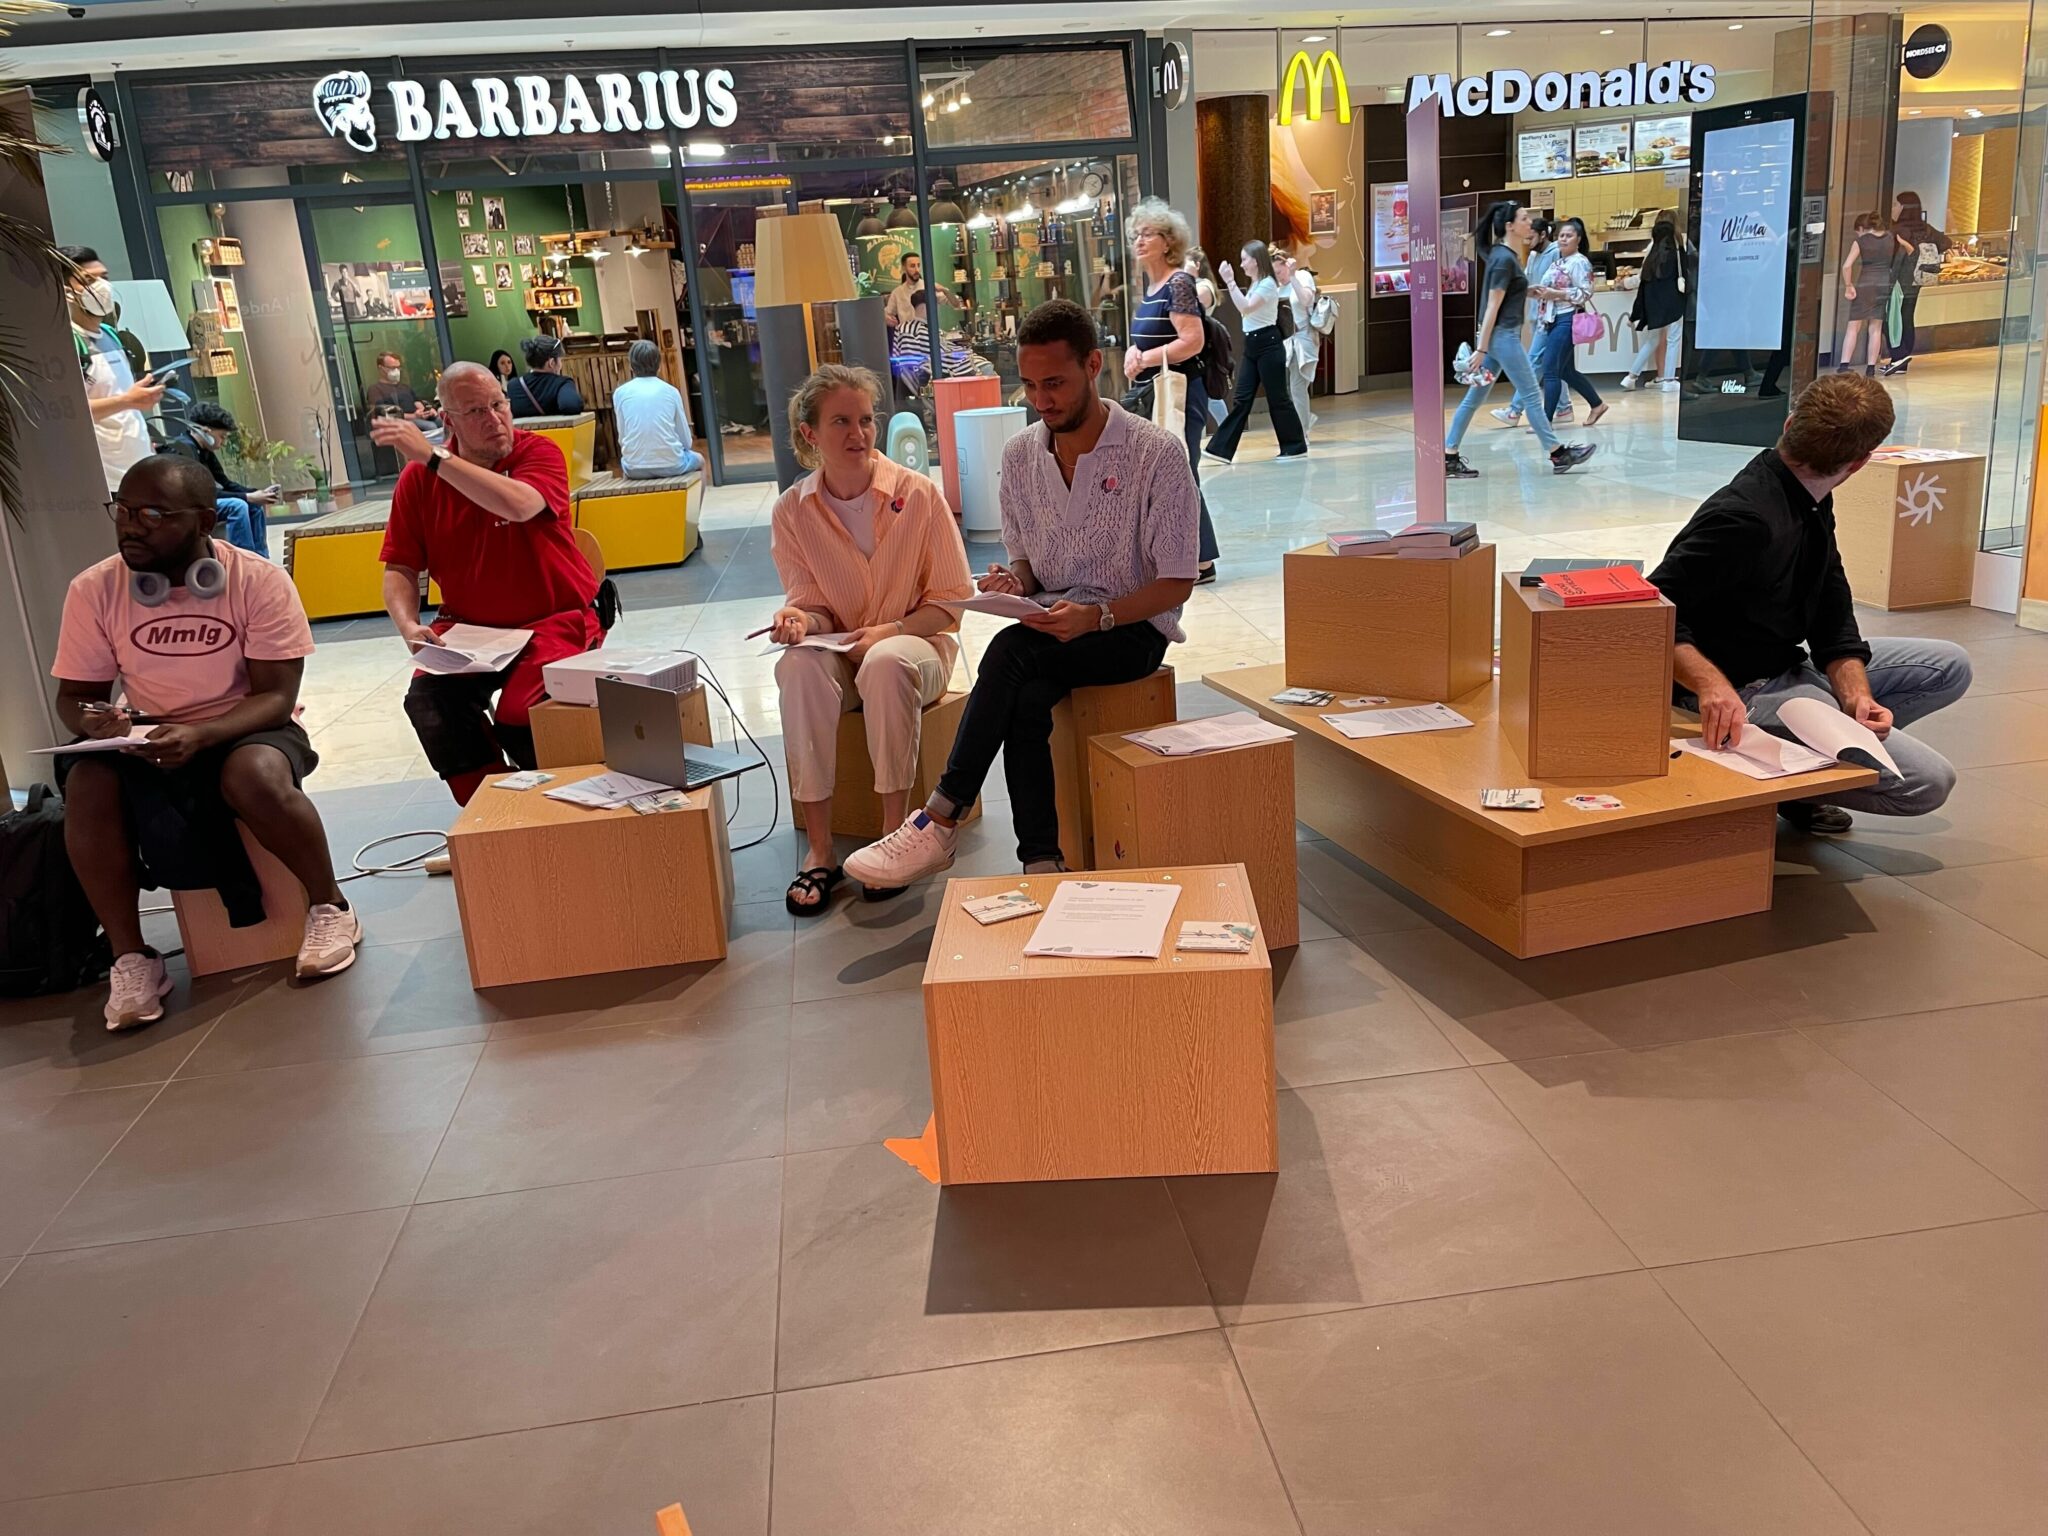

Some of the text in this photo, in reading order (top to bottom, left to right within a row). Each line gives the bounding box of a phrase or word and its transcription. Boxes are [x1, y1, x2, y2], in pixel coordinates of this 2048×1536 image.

[1906, 46, 1935, 58] NORDSEE
[1407, 60, 1716, 117] McDonald's
[387, 69, 738, 141] BARBARIUS
[1721, 215, 1766, 241] Wilma
[1721, 380, 1746, 393] Wilma
